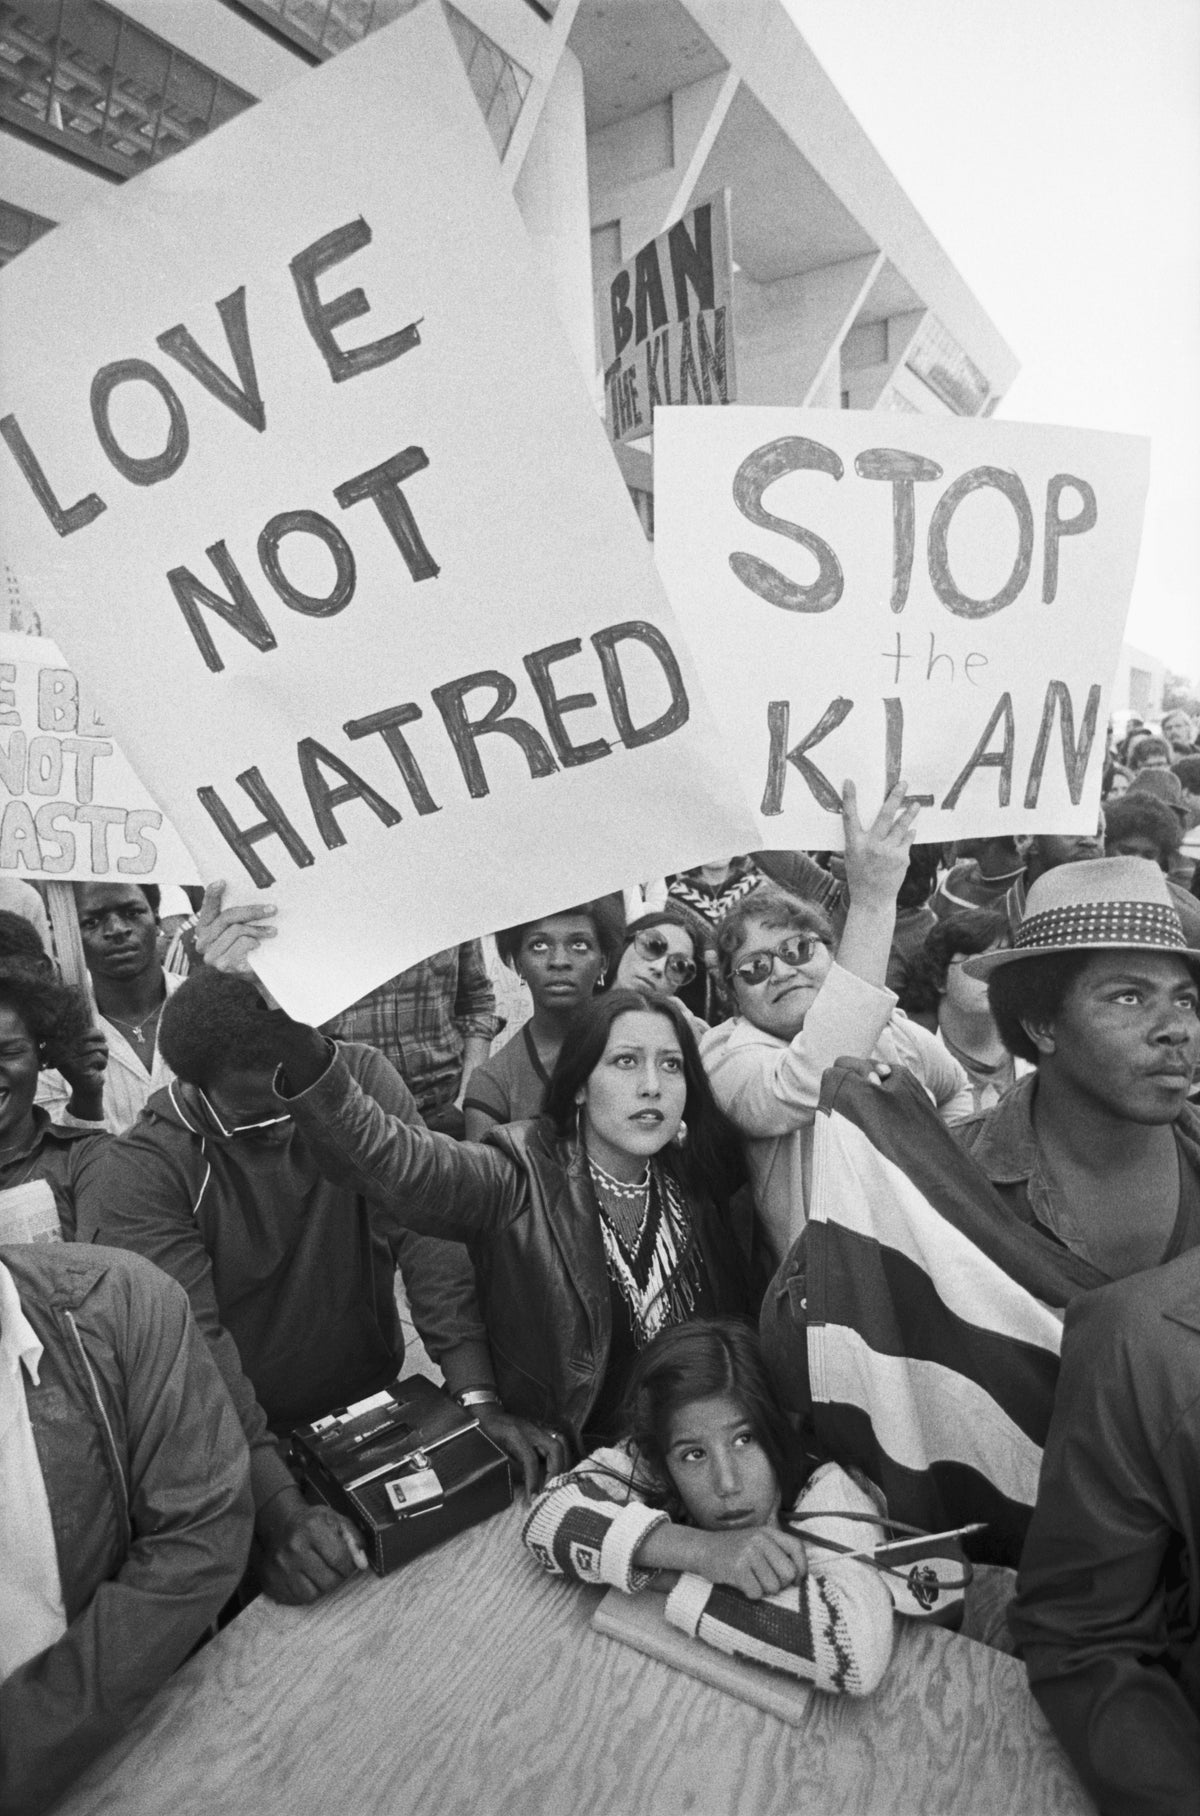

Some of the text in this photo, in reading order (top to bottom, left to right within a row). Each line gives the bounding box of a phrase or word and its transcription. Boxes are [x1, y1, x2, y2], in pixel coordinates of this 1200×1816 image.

[611, 203, 715, 357] BAN
[0, 215, 424, 537] LOVE
[604, 357, 643, 440] THE
[166, 446, 440, 673] NOT
[728, 435, 1098, 619] STOP
[881, 632, 989, 686] the
[196, 620, 690, 889] HATRED
[760, 679, 1101, 816] KLAN
[0, 800, 162, 875] ASTS
